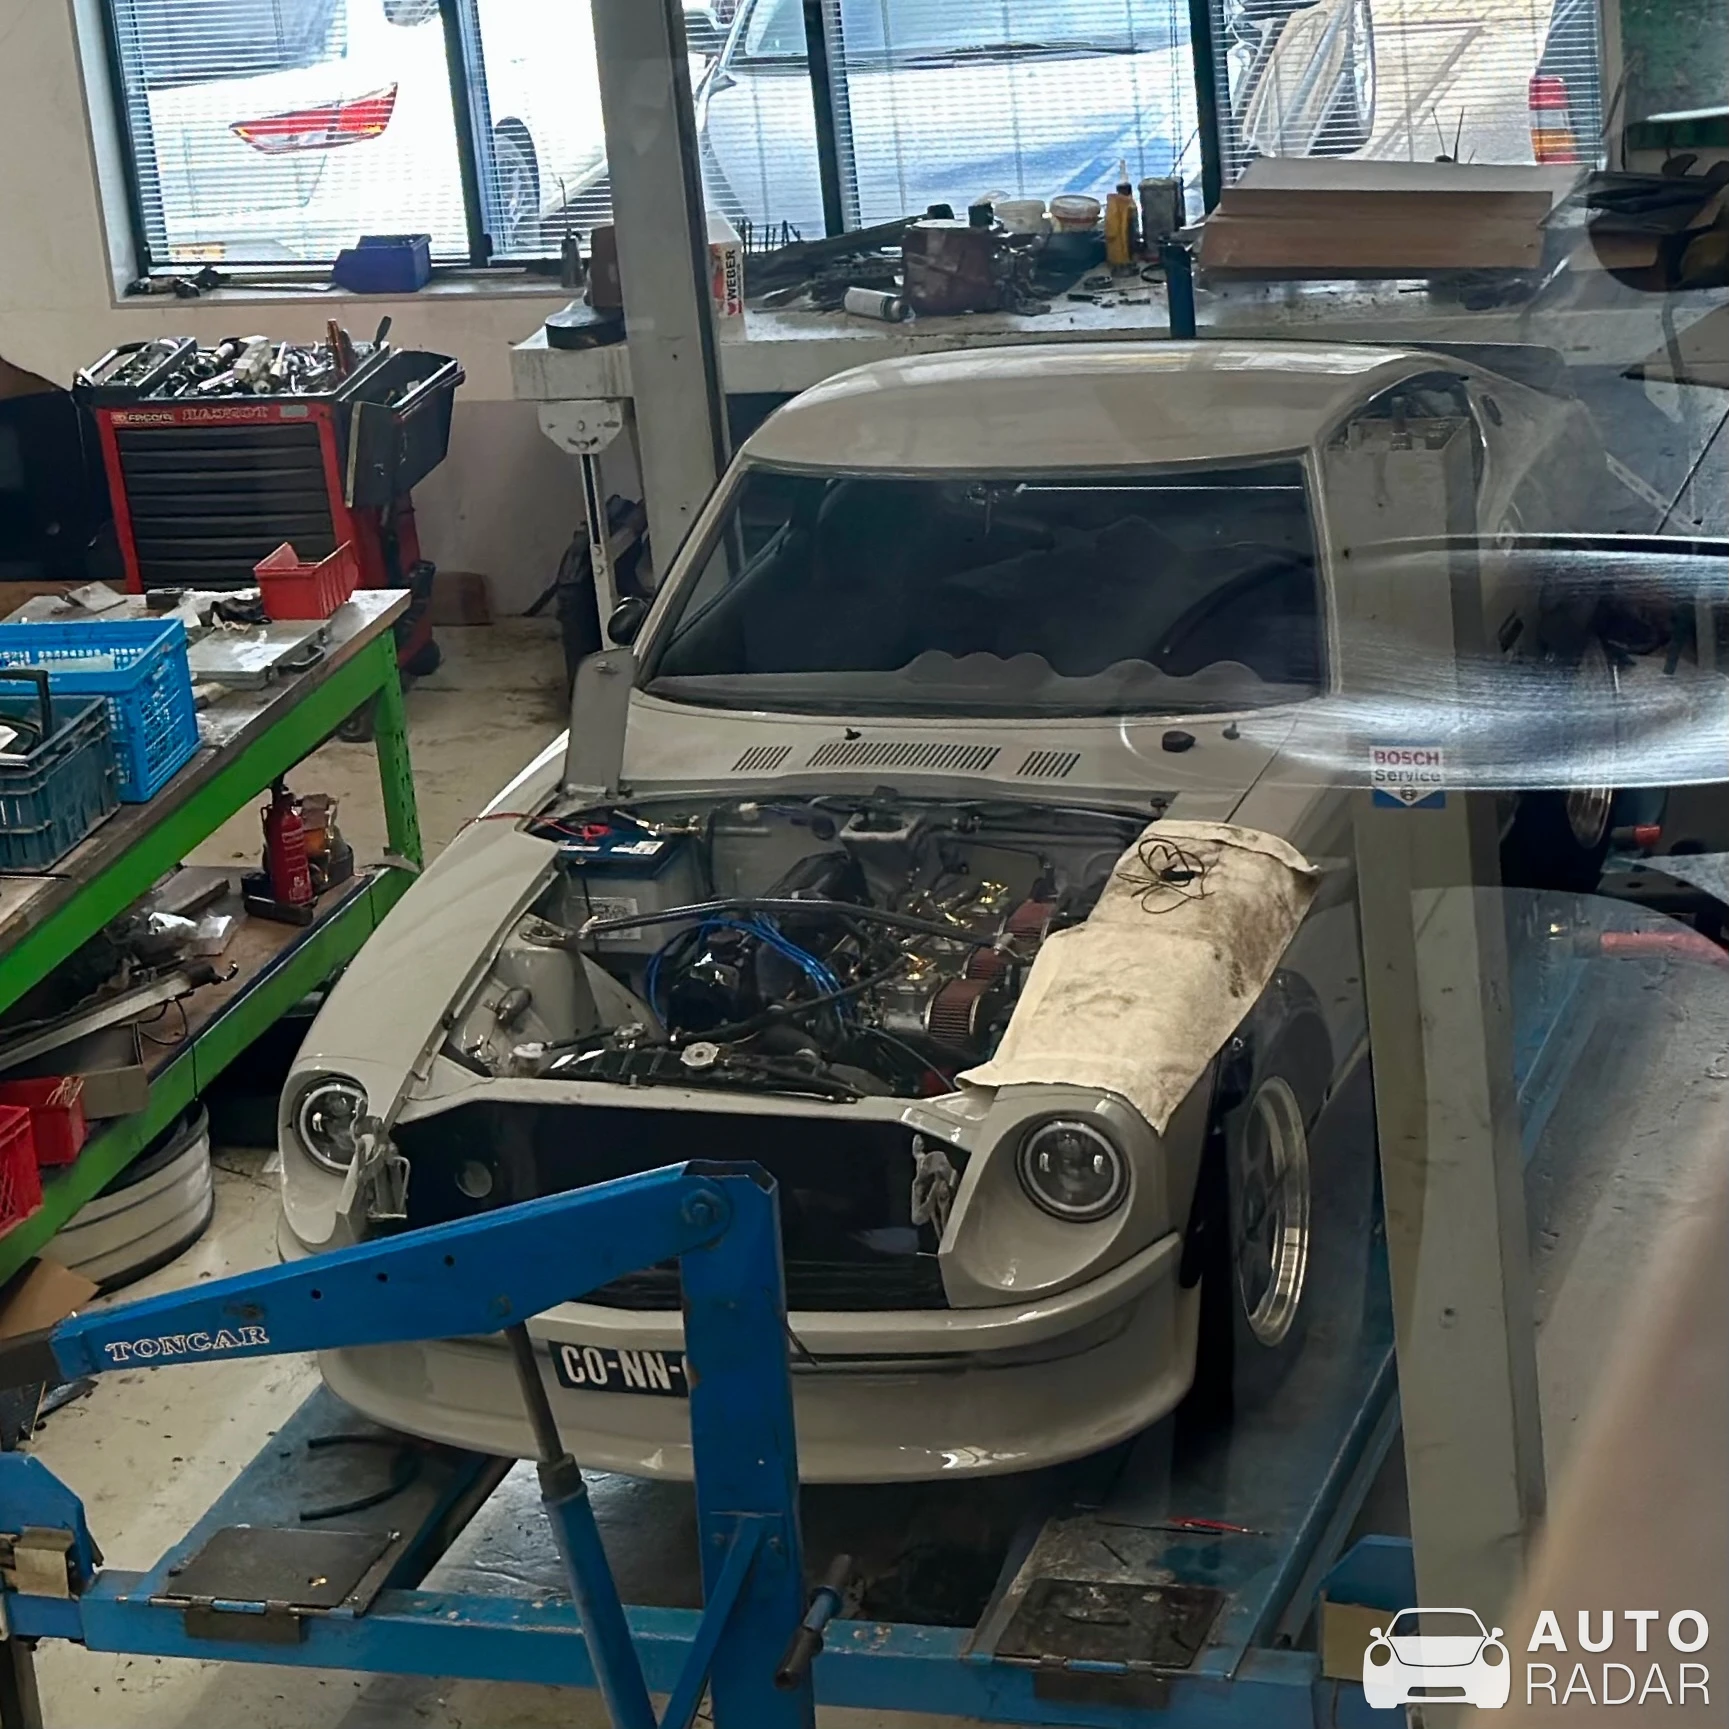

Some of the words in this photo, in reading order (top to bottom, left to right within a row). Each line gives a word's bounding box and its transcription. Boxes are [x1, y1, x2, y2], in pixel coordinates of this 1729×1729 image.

[725, 249, 737, 301] WEBER
[1374, 750, 1440, 765] BOSCH
[1374, 768, 1442, 782] Service
[104, 1326, 270, 1362] TONCAR
[560, 1345, 687, 1389] CO-NN-
